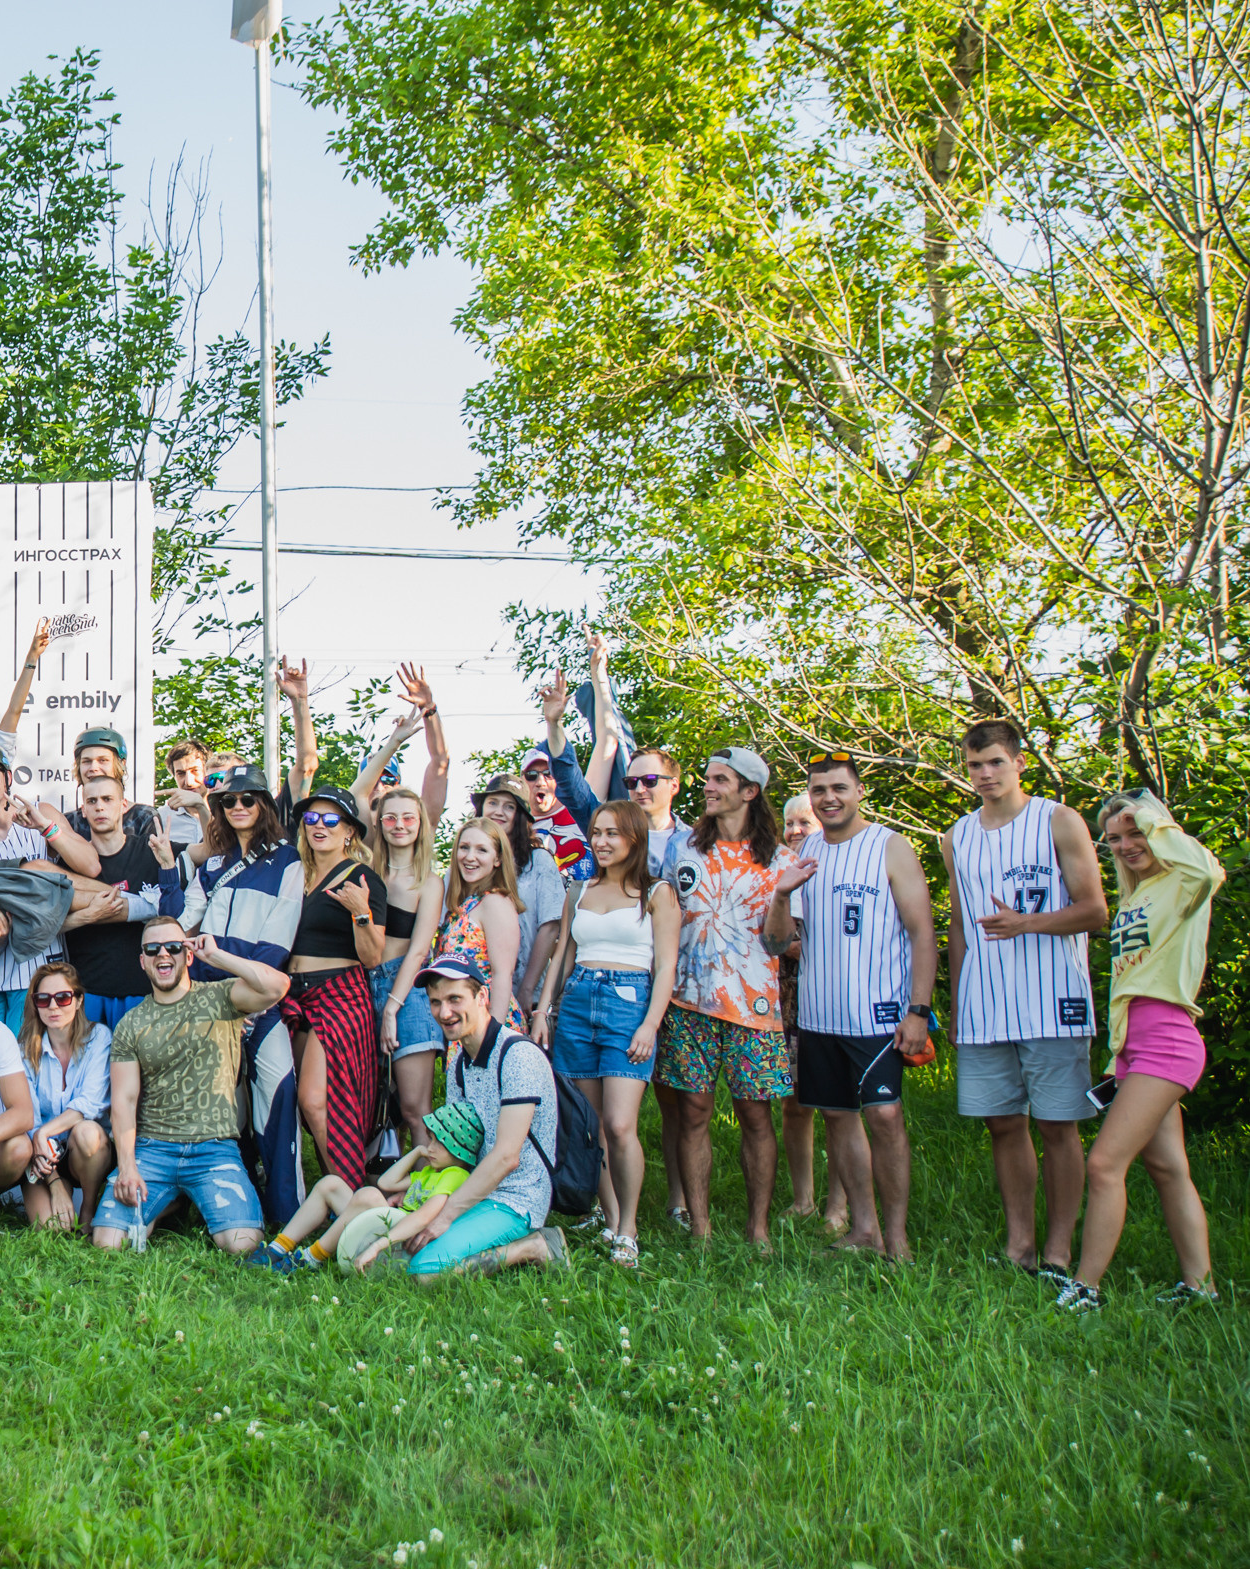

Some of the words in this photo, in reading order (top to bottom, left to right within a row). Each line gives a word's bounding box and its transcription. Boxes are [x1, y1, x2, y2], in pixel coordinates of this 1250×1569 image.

[14, 547, 122, 562] ИНГОССТРАХ
[46, 690, 122, 713] embily
[1013, 887, 1049, 914] 47
[843, 903, 862, 937] 5
